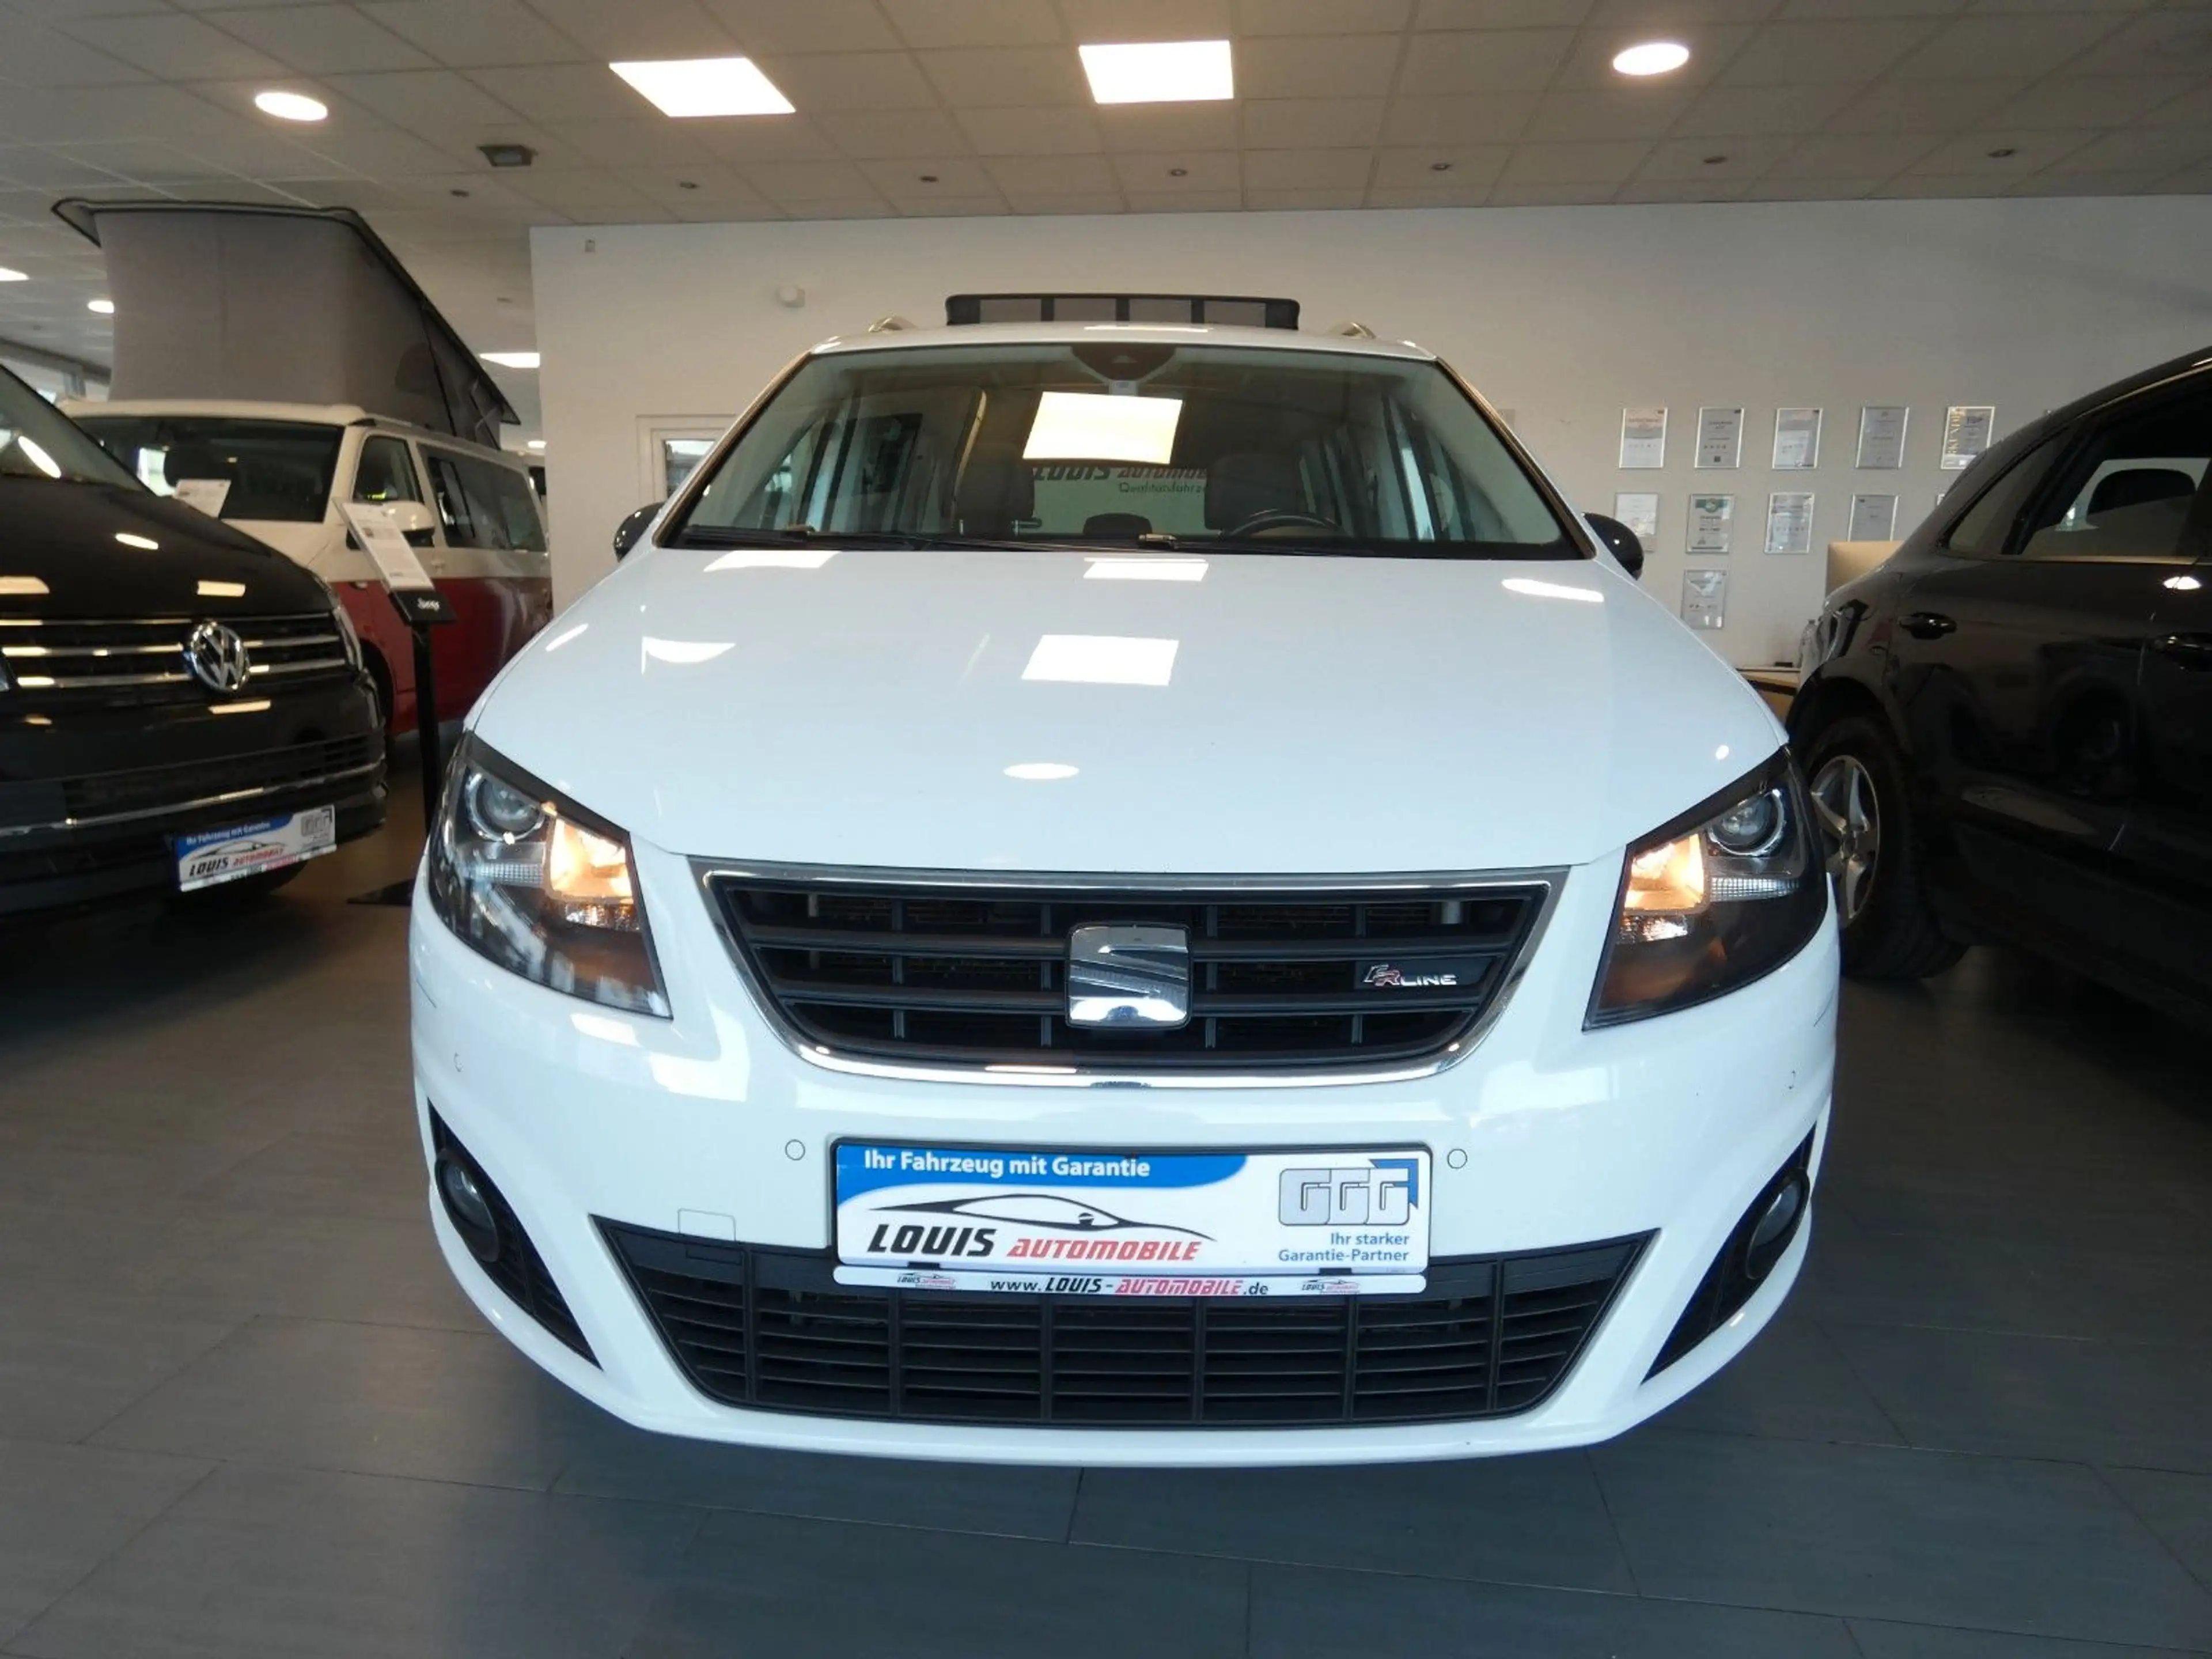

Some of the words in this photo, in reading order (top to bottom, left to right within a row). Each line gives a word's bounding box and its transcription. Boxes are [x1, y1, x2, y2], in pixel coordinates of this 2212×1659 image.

[189, 857, 229, 877] LOUIS
[1400, 974, 1457, 986] LINE
[865, 1150, 893, 1169] Ihr
[901, 1152, 1003, 1178] Fahrzeug
[1010, 1155, 1047, 1175] mit
[1052, 1157, 1150, 1177] Garantie
[868, 1224, 997, 1257] LOUIS
[1331, 1233, 1351, 1245] Ihr
[1355, 1233, 1410, 1245] starker
[1278, 1248, 1410, 1262] Garantie-Partner
